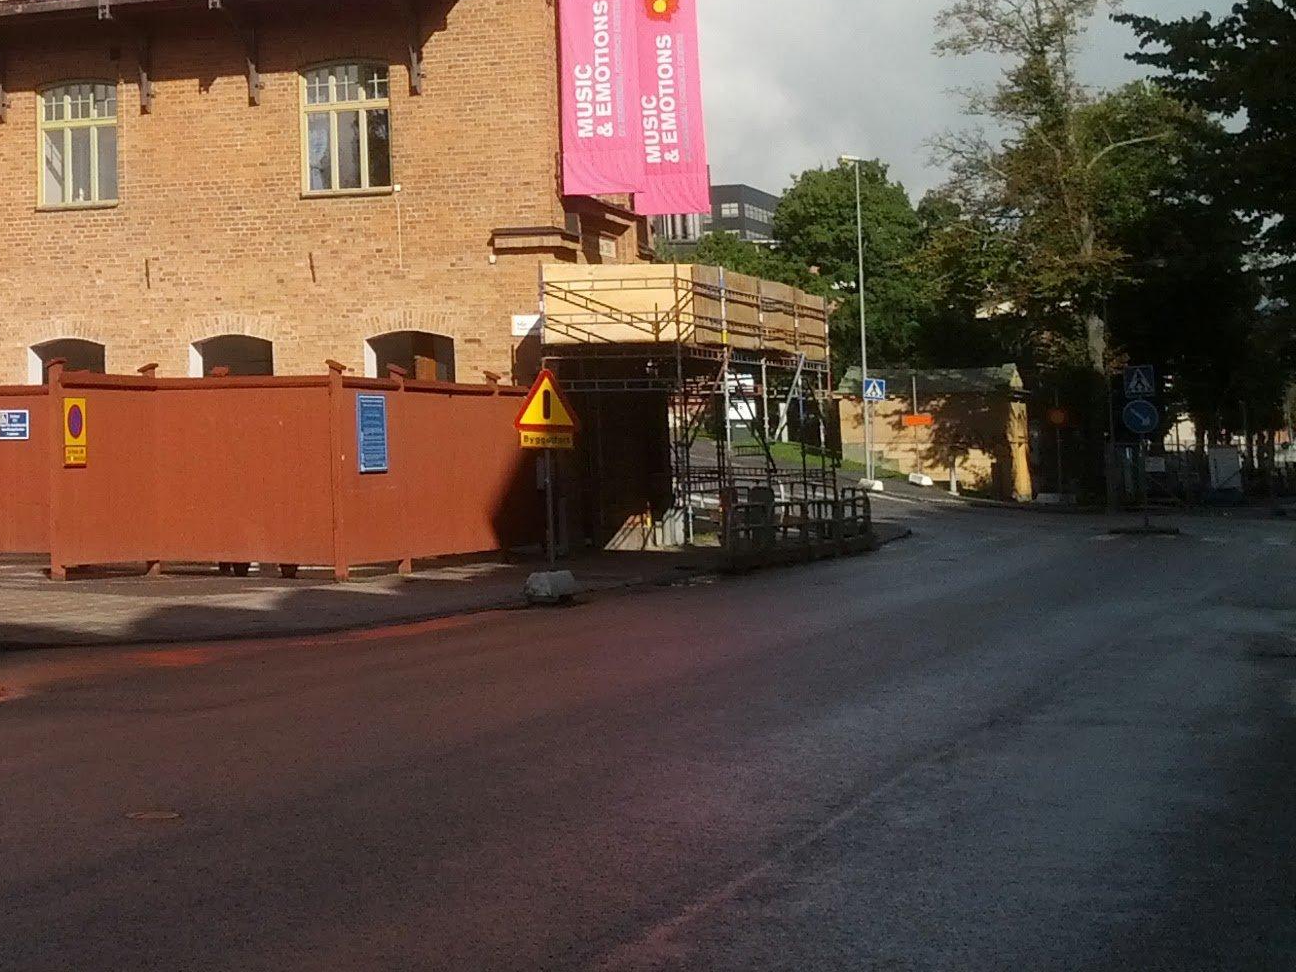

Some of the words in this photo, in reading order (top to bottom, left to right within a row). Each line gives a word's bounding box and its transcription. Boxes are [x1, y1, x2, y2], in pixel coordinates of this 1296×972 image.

[592, 0, 612, 117] EMOTIONS
[655, 34, 677, 144] EMOTIONS
[574, 64, 594, 138] MUSIC
[596, 121, 614, 137] &
[640, 94, 662, 164] MUSIC
[663, 148, 679, 163] &
